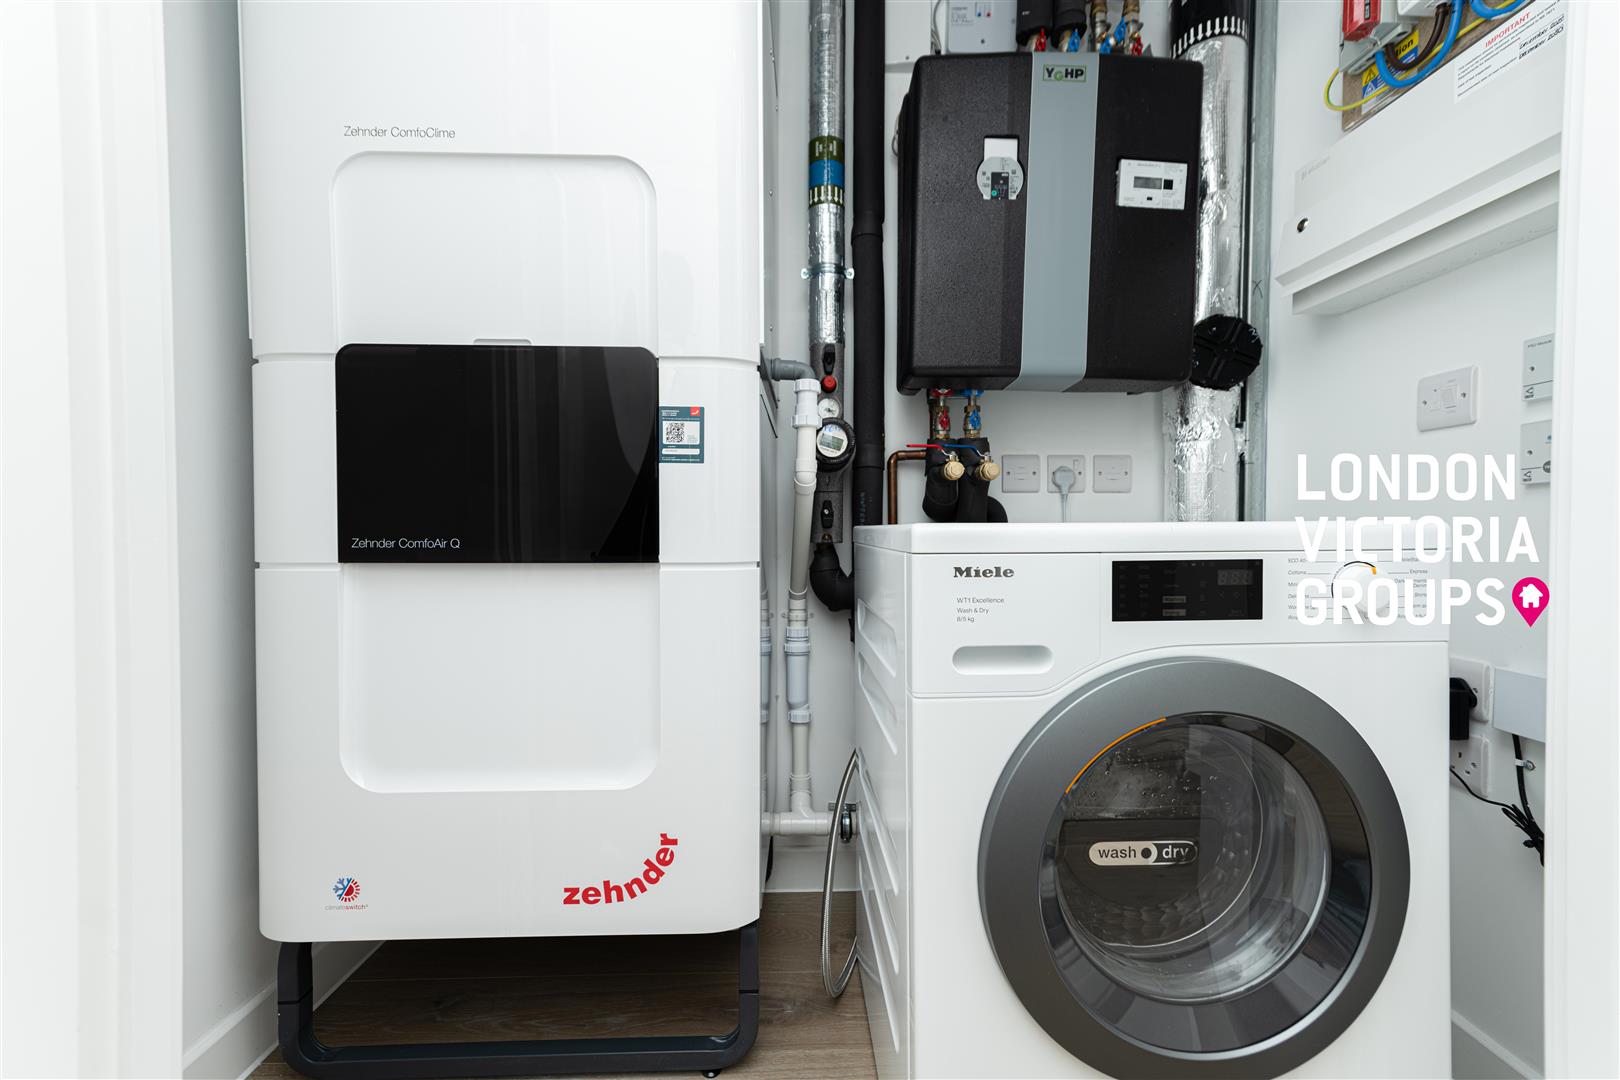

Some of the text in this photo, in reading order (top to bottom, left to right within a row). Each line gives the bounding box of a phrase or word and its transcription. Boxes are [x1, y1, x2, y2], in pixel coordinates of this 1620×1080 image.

[1485, 12, 1531, 48] IMPORTANT
[343, 125, 456, 138] Zehnder ComfoClime
[351, 537, 461, 549] Zehnder ComfoAir Q
[953, 566, 1015, 578] Miele
[979, 607, 989, 615] Dry
[967, 616, 975, 624] kg
[1098, 845, 1189, 861] wash dry
[563, 833, 679, 905] zehnder
